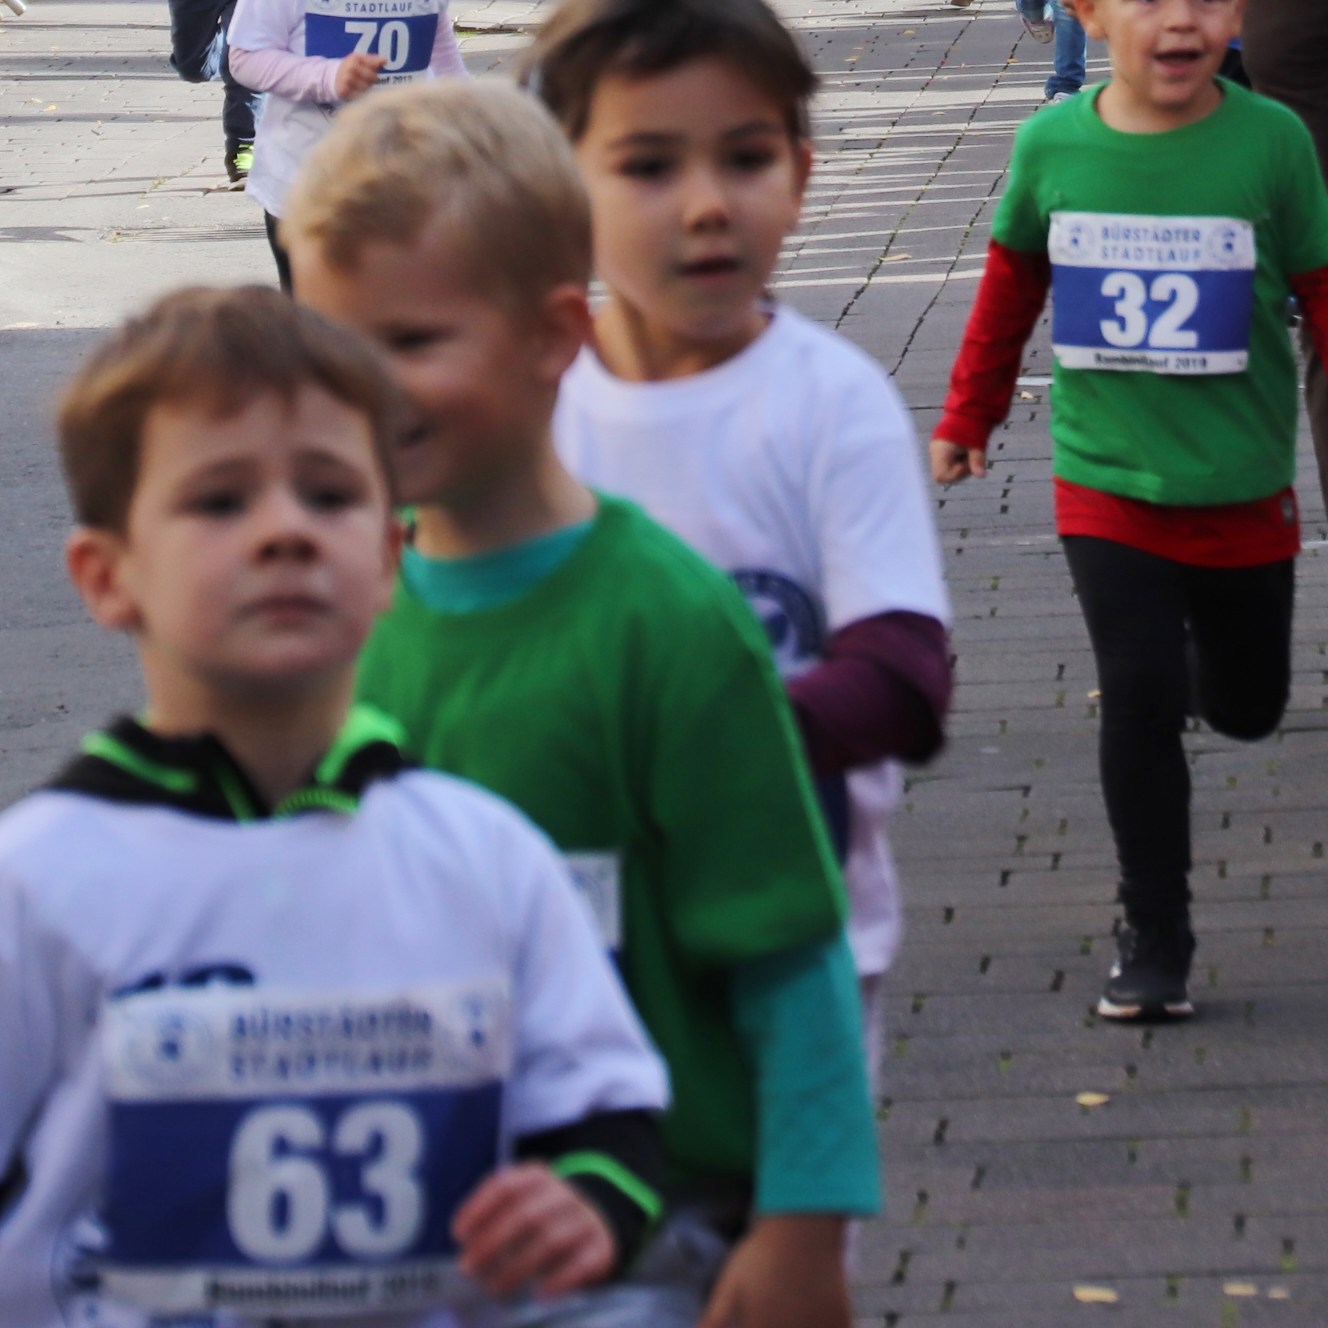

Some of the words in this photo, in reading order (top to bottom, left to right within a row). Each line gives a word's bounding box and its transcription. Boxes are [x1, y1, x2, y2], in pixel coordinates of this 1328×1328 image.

[345, 2, 413, 13] STADTLAUF
[344, 19, 410, 71] 70
[1101, 224, 1202, 244] BÜRSTÄDTER
[1101, 246, 1202, 263] STADTLAUF
[1099, 270, 1200, 349] 32
[227, 1101, 424, 1264] 63
